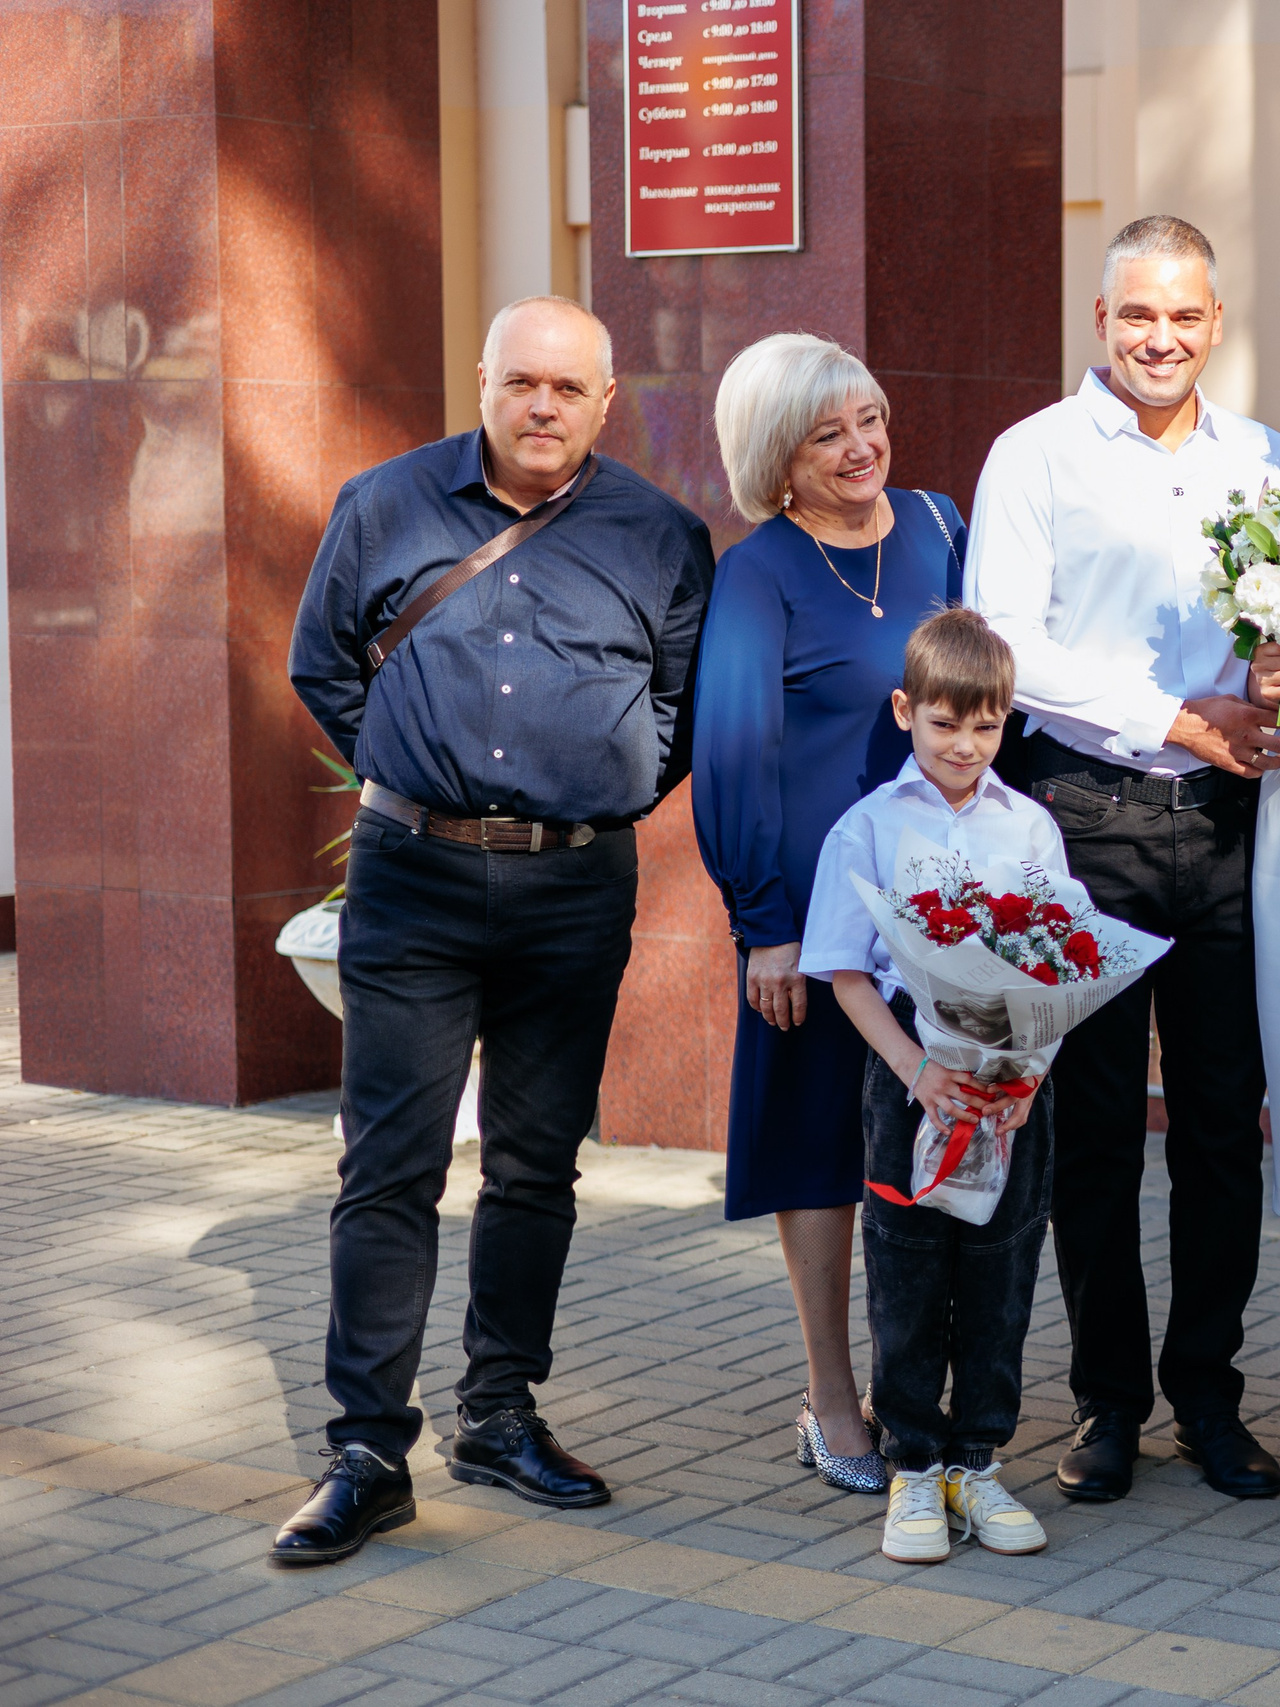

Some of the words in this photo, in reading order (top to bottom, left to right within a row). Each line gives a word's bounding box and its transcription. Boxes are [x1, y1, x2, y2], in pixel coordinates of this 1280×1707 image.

[637, 4, 687, 19] Вторник
[731, 0, 747, 11] до
[637, 30, 673, 46] Среда
[710, 23, 733, 37] 9:00
[733, 25, 749, 37] до
[750, 20, 778, 35] 18:00
[638, 56, 683, 70] Четверг
[758, 51, 778, 61] день
[638, 82, 689, 95] Пятница
[711, 76, 733, 90] 9:00
[733, 77, 749, 90] до
[750, 73, 778, 88] 17:00
[638, 107, 686, 124] Суббота
[711, 102, 733, 116] 9:00
[733, 104, 749, 116] до
[750, 99, 778, 114] 18:00
[639, 146, 690, 163] Перерыв
[711, 143, 736, 156] 13:00
[737, 144, 752, 156] до
[640, 186, 698, 200] Выходные
[704, 182, 781, 196] понедельник
[704, 200, 775, 216] воскресенье
